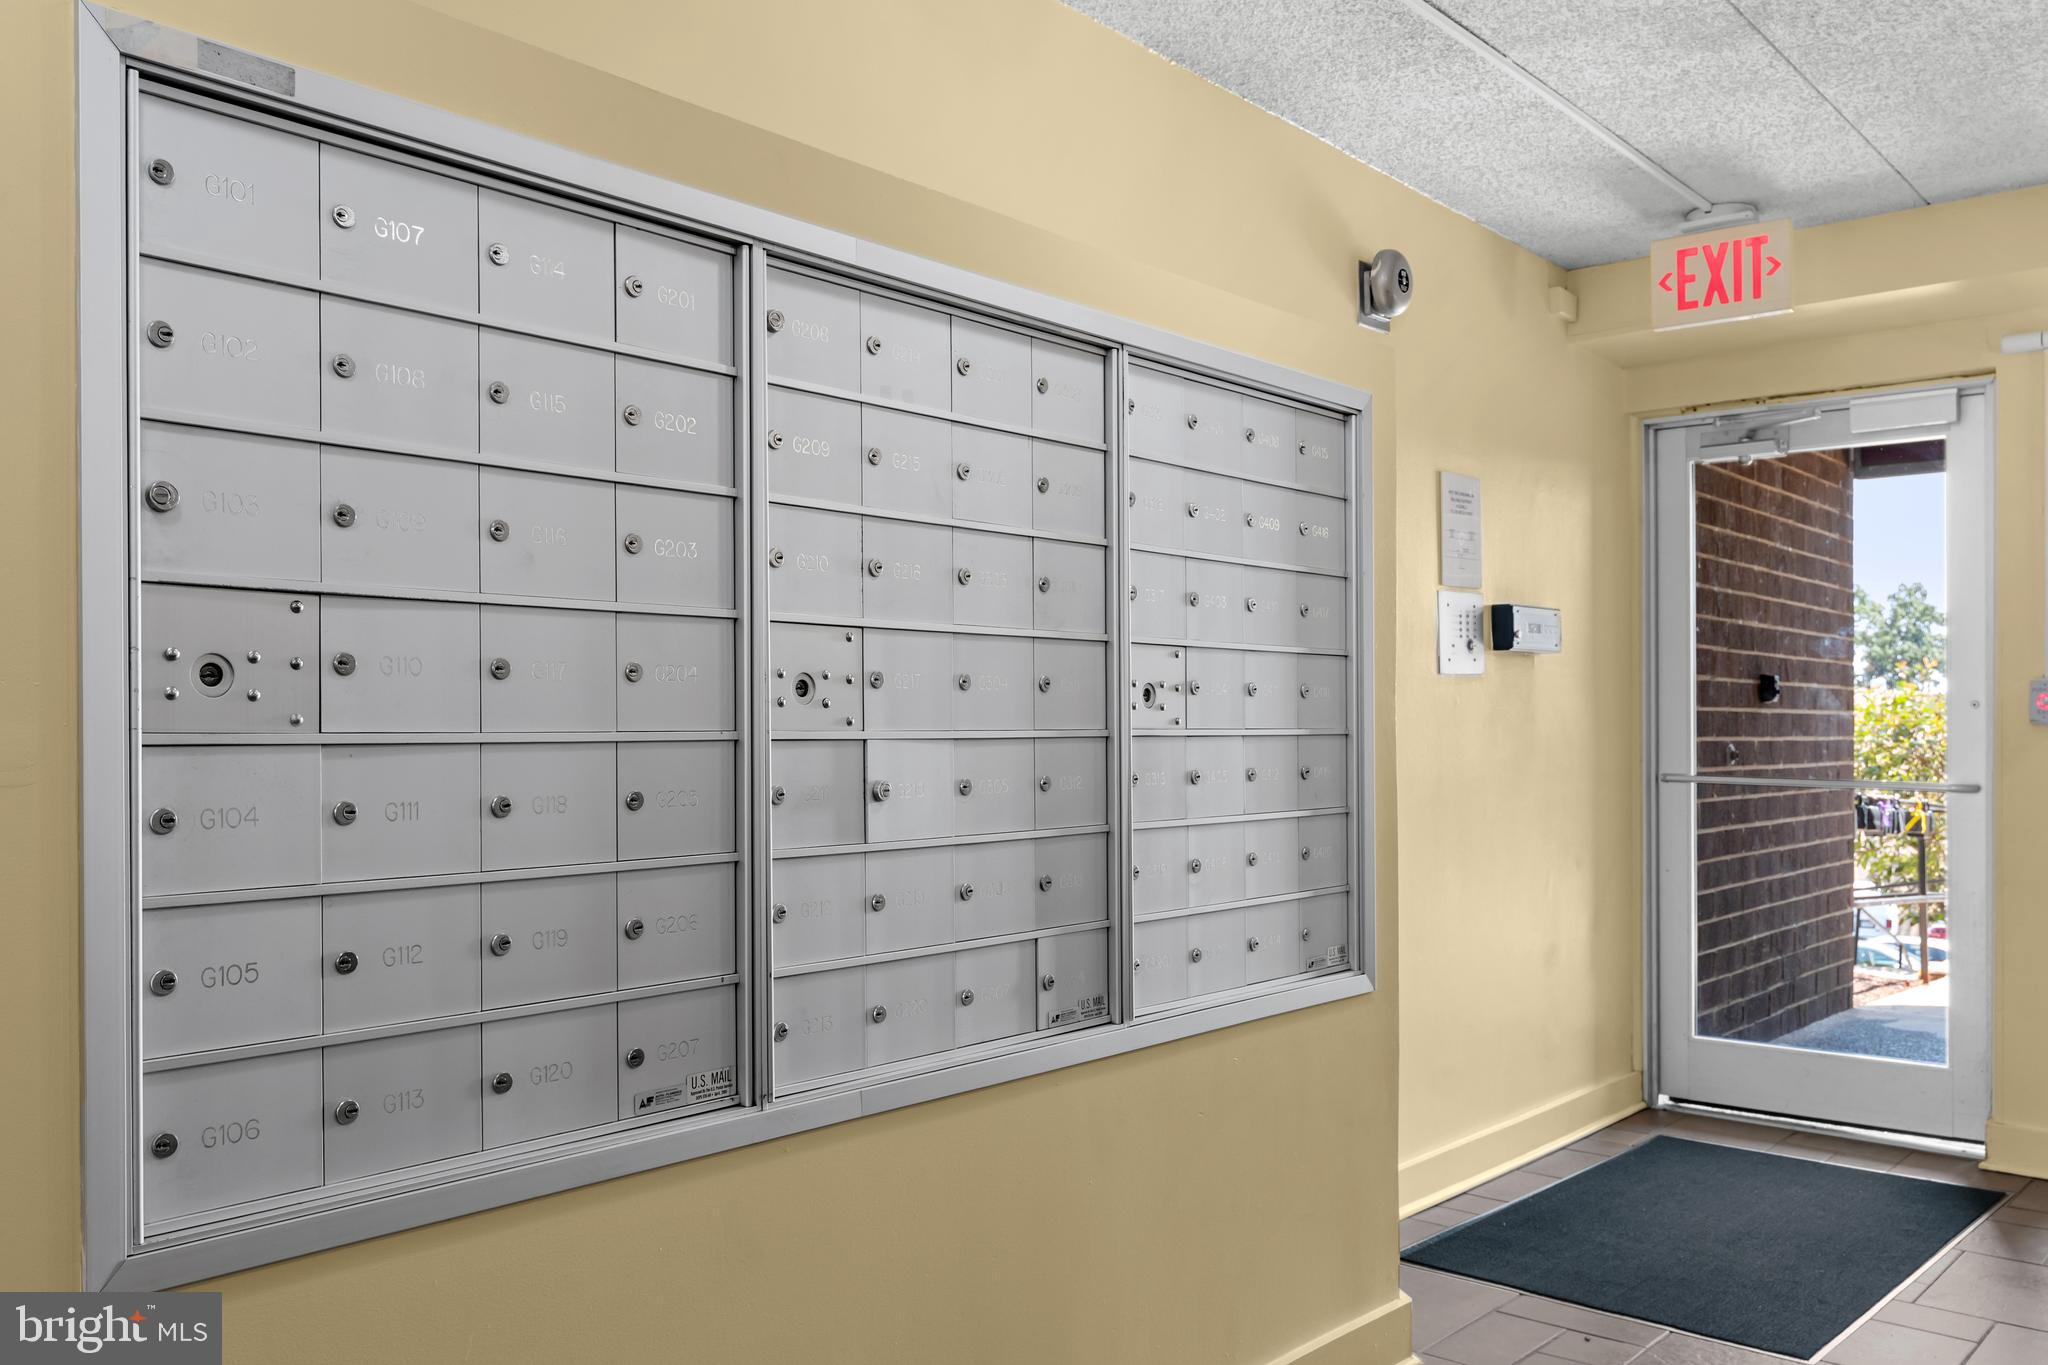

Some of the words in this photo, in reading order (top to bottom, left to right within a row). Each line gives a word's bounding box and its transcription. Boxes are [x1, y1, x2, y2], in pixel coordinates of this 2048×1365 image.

[375, 217, 424, 245] G107
[1676, 234, 1769, 312] EXIT
[657, 286, 695, 311] G201
[201, 331, 258, 361] G102
[376, 363, 424, 389] G108
[655, 411, 697, 435] G202
[793, 436, 830, 457] G209
[1258, 516, 1280, 531] G409
[654, 538, 697, 559] G203
[379, 655, 423, 678] G110
[385, 801, 420, 822] G111
[532, 795, 568, 815] G118
[200, 806, 259, 830] G104
[532, 929, 568, 950] G119
[382, 944, 423, 967] G112
[201, 962, 259, 988] G105
[657, 1038, 699, 1061] G207
[530, 1061, 573, 1086] G120
[691, 1074, 708, 1089] U.S.
[711, 1069, 732, 1085] MAIL
[383, 1088, 424, 1114] G113
[202, 1118, 260, 1148] G106
